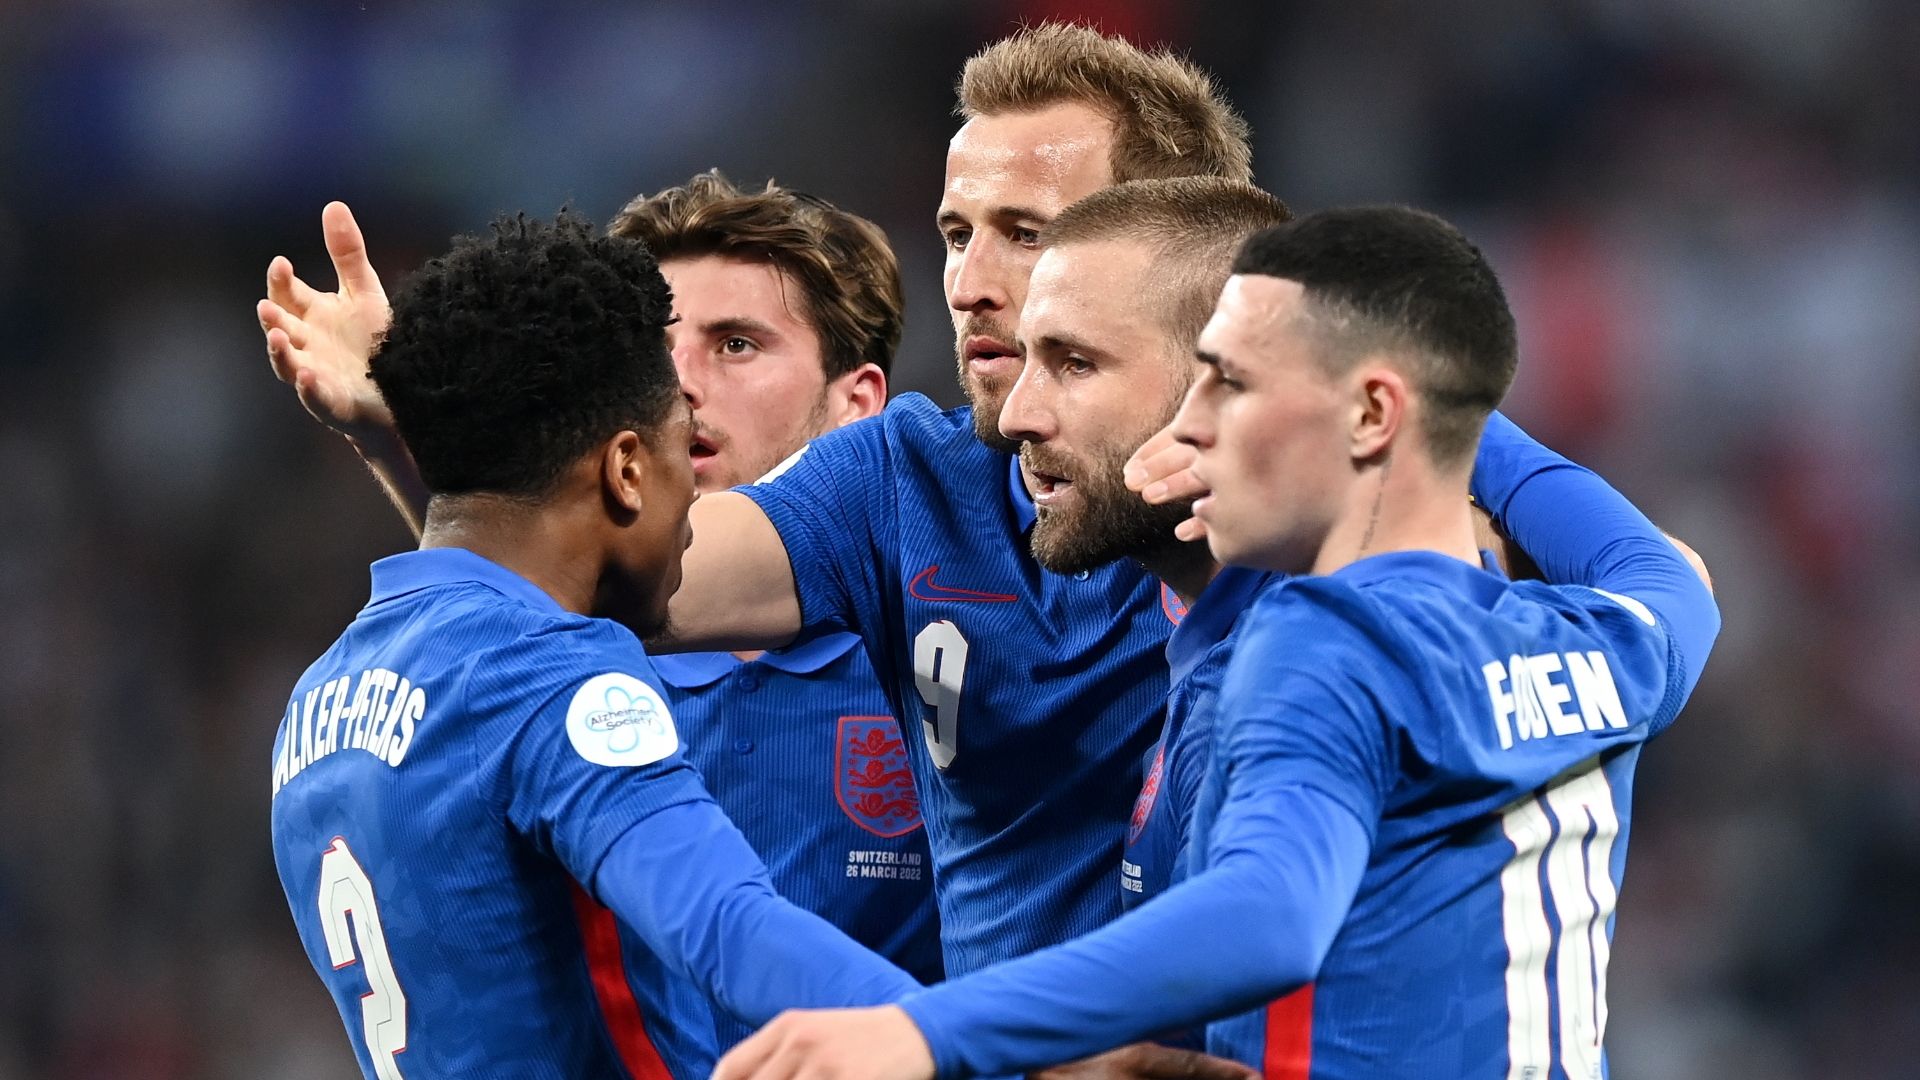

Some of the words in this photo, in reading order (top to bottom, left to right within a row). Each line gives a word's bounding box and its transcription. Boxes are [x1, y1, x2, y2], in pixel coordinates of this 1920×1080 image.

[272, 668, 426, 801] ALKER-PETERS
[914, 619, 968, 769] 9
[846, 864, 859, 878] 26
[860, 865, 897, 879] MARCH
[899, 867, 922, 881] 2022
[848, 850, 922, 866] SWITZERLAND
[1495, 752, 1618, 1080] 10
[318, 836, 407, 1080] 2
